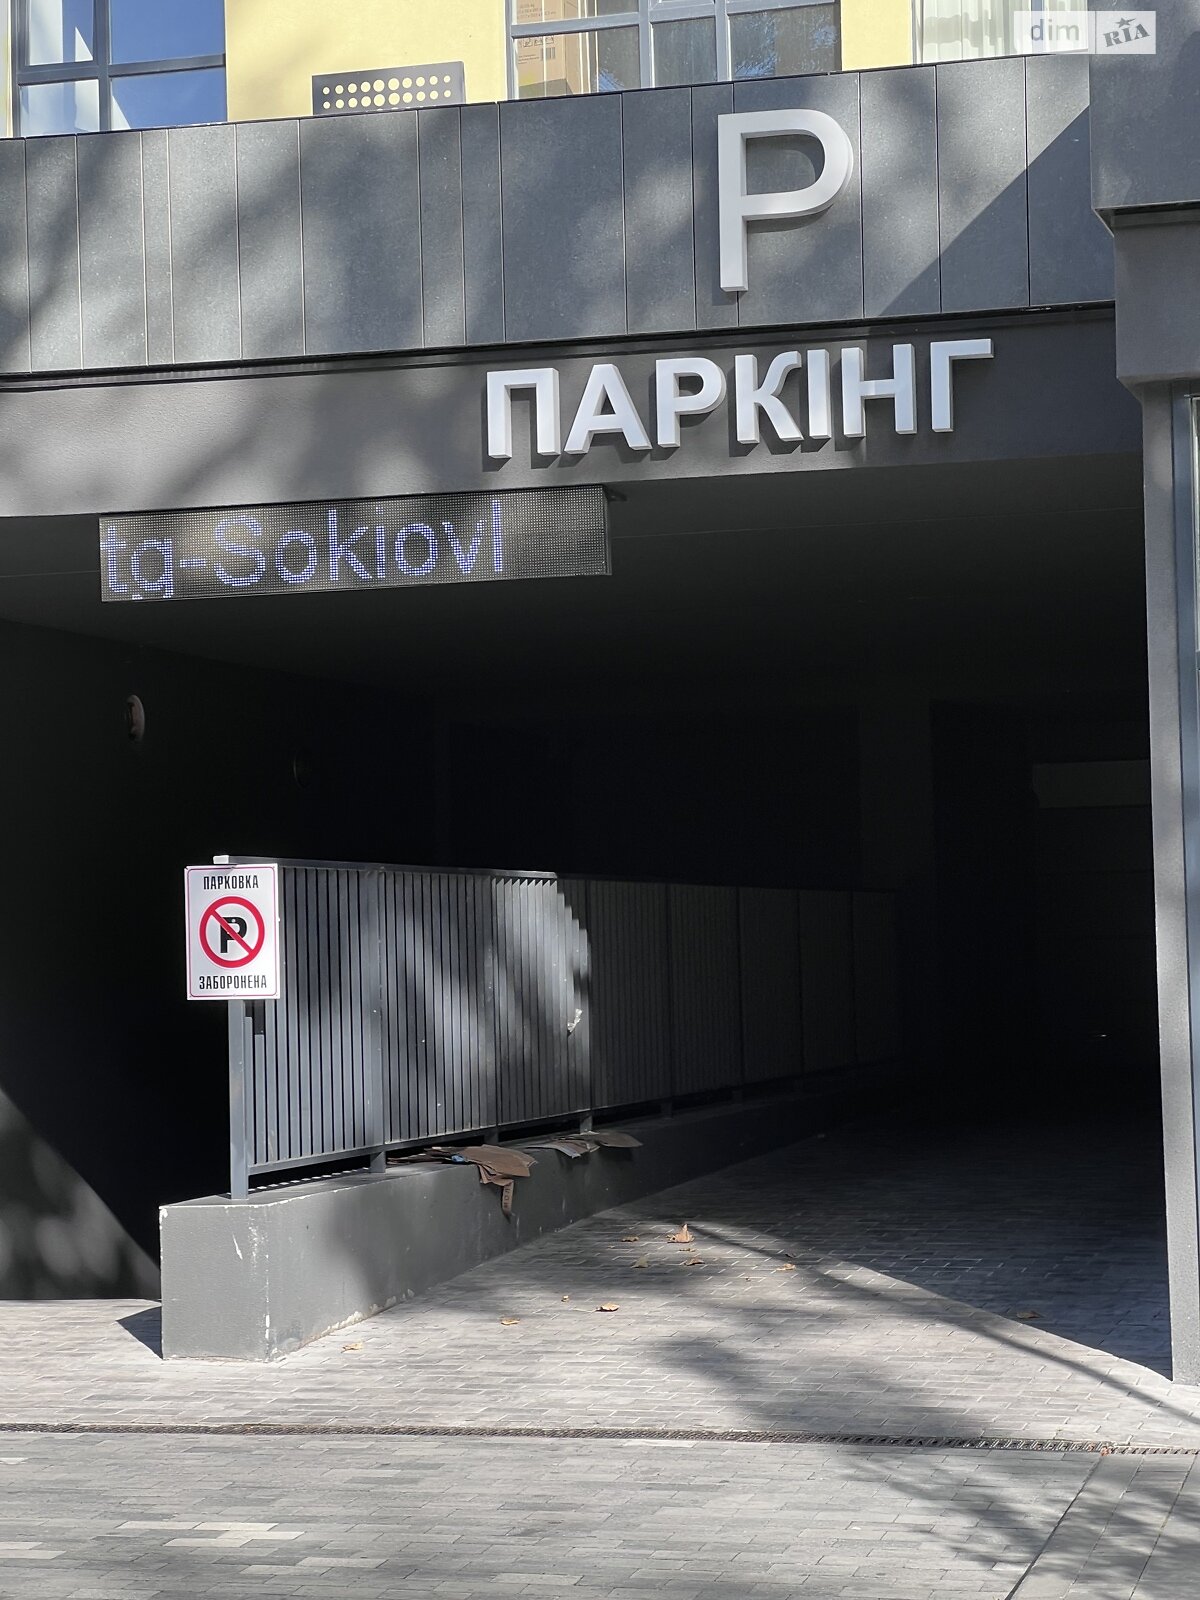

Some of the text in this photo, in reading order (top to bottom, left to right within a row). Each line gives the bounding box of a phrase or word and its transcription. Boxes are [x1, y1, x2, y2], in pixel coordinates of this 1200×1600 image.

[717, 108, 854, 293] P
[486, 338, 995, 459] ПАРКІНГ
[203, 874, 260, 890] ПАРКОВКА
[220, 916, 248, 954] P
[199, 974, 268, 990] ЗАБОРОНЕНА
